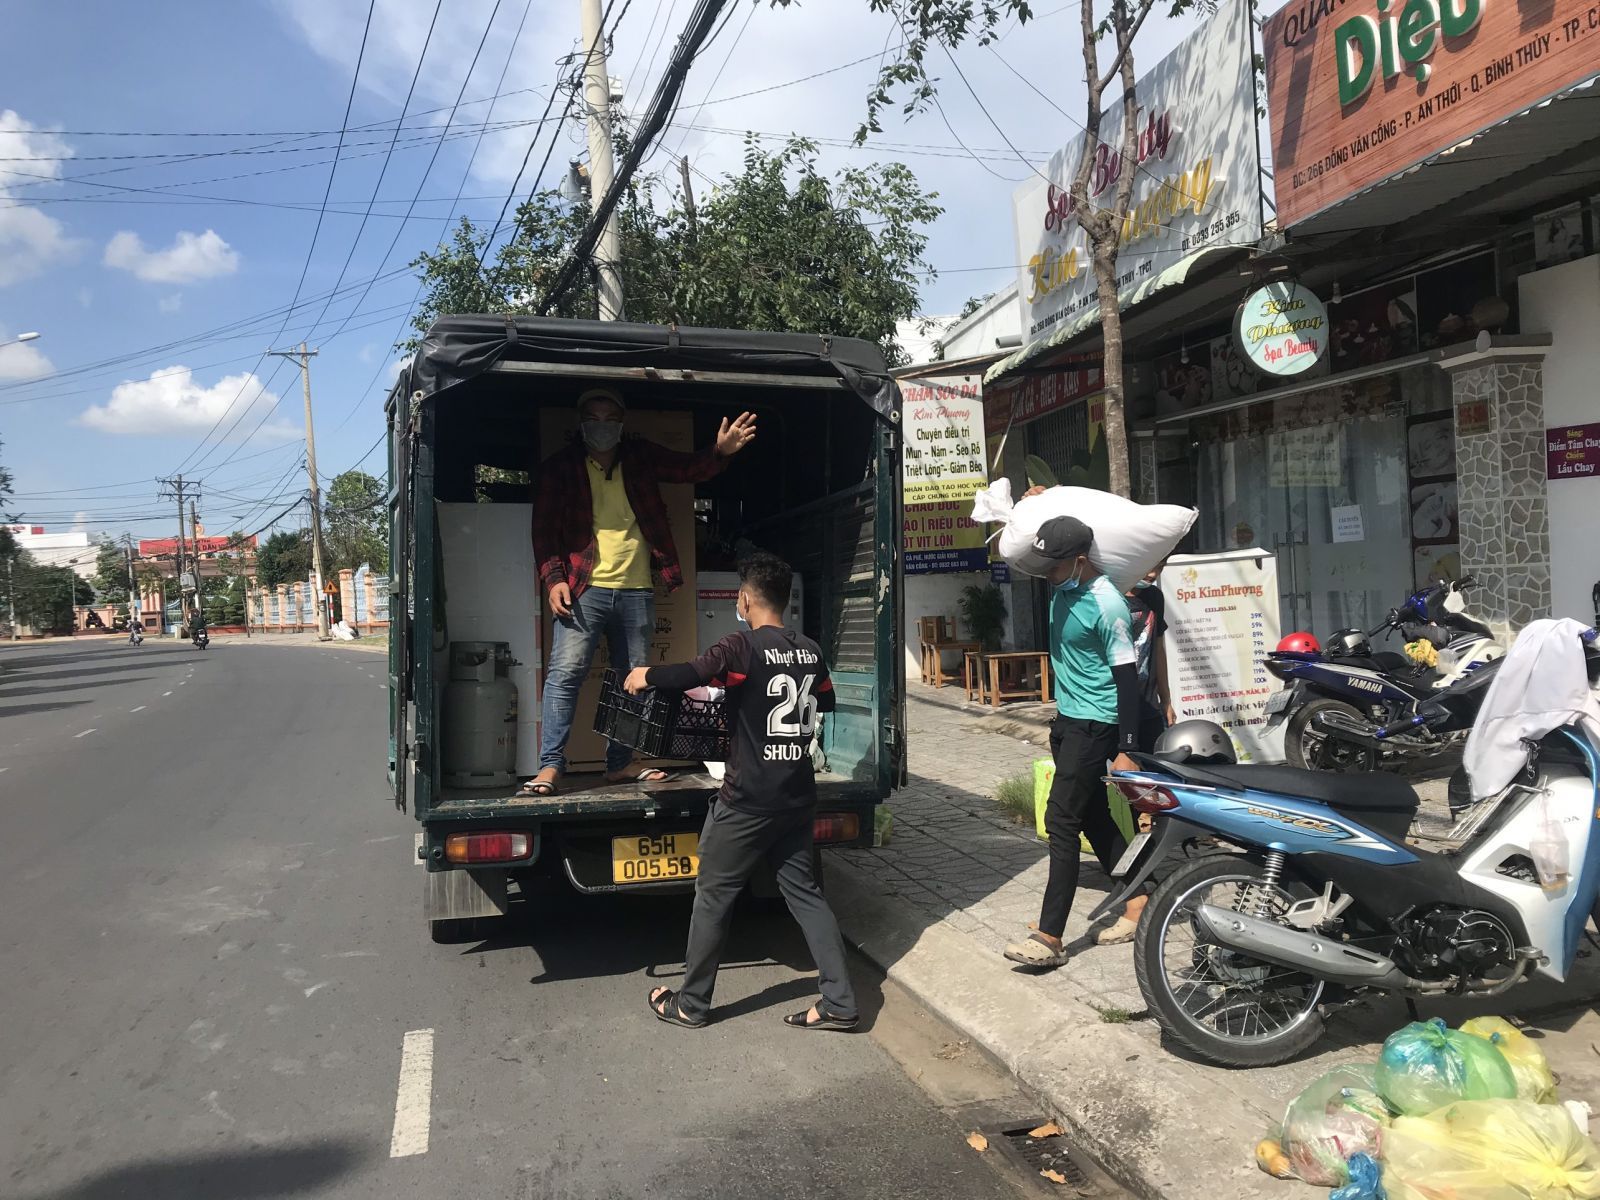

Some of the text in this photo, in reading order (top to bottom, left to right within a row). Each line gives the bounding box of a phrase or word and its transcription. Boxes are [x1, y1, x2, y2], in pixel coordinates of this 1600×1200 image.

[1418, 99, 1433, 121] AN
[1471, 73, 1483, 92] Q.
[1210, 219, 1224, 236] 255
[1225, 209, 1240, 228] 355
[1026, 246, 1079, 304] Kim
[1138, 259, 1153, 277] TPCT
[1260, 299, 1306, 317] Kim
[1264, 336, 1319, 364] Spa Beauty
[912, 407, 933, 421] Kim
[916, 427, 942, 443] Chuyên
[1567, 439, 1584, 450] Tâm
[1557, 461, 1596, 474] Lẩu Chay
[1176, 583, 1265, 604] Spa KimPhượng
[795, 648, 819, 665] Hào
[1346, 676, 1385, 695] YAMAHA
[766, 673, 819, 737] 26
[638, 835, 676, 857] 65H
[623, 856, 693, 880] 005.58
